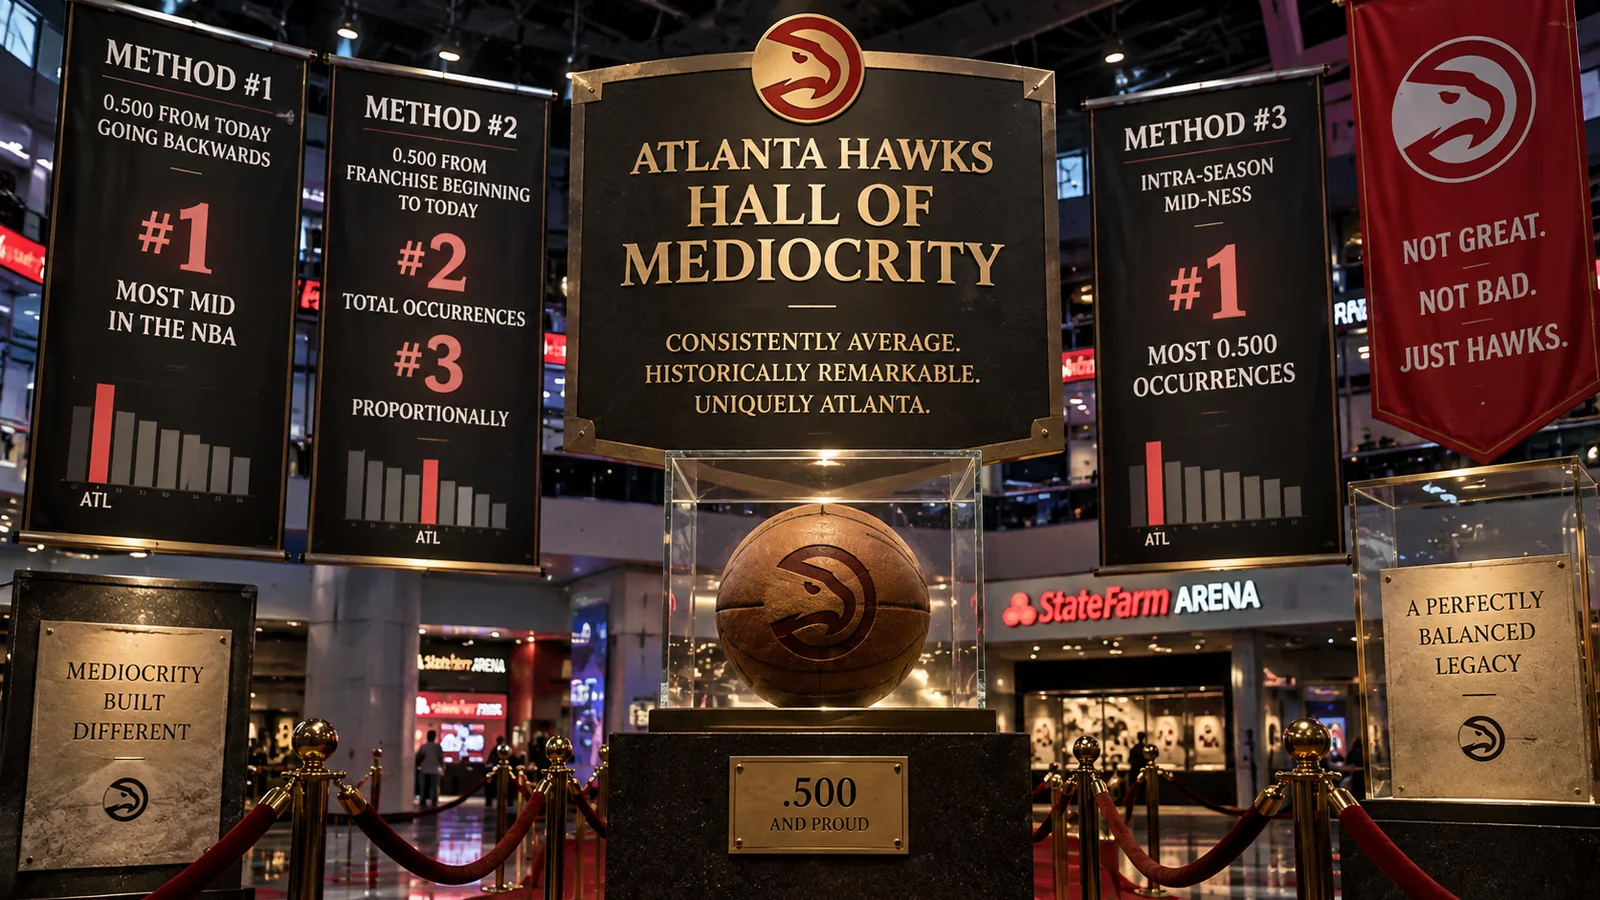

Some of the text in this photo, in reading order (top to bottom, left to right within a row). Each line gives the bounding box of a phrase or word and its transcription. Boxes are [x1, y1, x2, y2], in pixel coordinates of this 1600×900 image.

[105, 38, 273, 101] METHOD #1
[103, 93, 271, 143] 0.500 FROM TODAY
[364, 94, 518, 140] METHOD #2
[1123, 104, 1288, 152] METHOD #3
[97, 118, 271, 168] GOING BACKWARDS
[630, 137, 995, 175] ATLANTA HAWKS
[392, 147, 488, 175] 0.500 FROM
[1140, 156, 1275, 192] INTRA-SEASON
[346, 164, 531, 203] FRANCHISE BEGINNING
[1164, 185, 1252, 213] MID-NESS
[398, 194, 479, 219] TO TODAY
[687, 183, 934, 228] HALL OF
[137, 201, 212, 275] #1
[1403, 212, 1546, 264] NOT GREAT.
[396, 232, 467, 292] #2
[620, 238, 1005, 287] MEDIOCRITY
[115, 279, 236, 316] MOST MID
[1168, 243, 1247, 320] #1
[1419, 272, 1537, 316] NOT BAD.
[108, 309, 237, 346] IN THE NBA
[342, 292, 526, 328] TOTAL OCCURRENCES
[665, 332, 962, 353] CONSISTENTLY AVERAGE.
[1147, 333, 1278, 366] MOST 0.500
[1400, 322, 1569, 373] JUST HAWKS.
[393, 333, 464, 394] #3
[644, 362, 982, 384] HISTORICALLY REMARKABLE.
[1132, 362, 1296, 397] OCCURRENCES
[351, 398, 509, 428] PROPORTIONALLY
[694, 393, 932, 418] UNIQUELY ATLANTA.
[79, 491, 112, 509] ATL
[415, 530, 441, 545] ATL
[1144, 531, 1171, 547] ATL
[1174, 580, 1261, 615] ARENA
[1406, 590, 1544, 617] A PERFECTLY
[1419, 622, 1536, 646] BALANCED
[66, 661, 204, 684] MEDIOCRITY
[1435, 653, 1522, 675] LEGACY
[103, 692, 166, 711] BUILT
[72, 722, 191, 741] DIFFERENT
[783, 776, 857, 808] .500
[769, 816, 870, 832] AND PROUD
